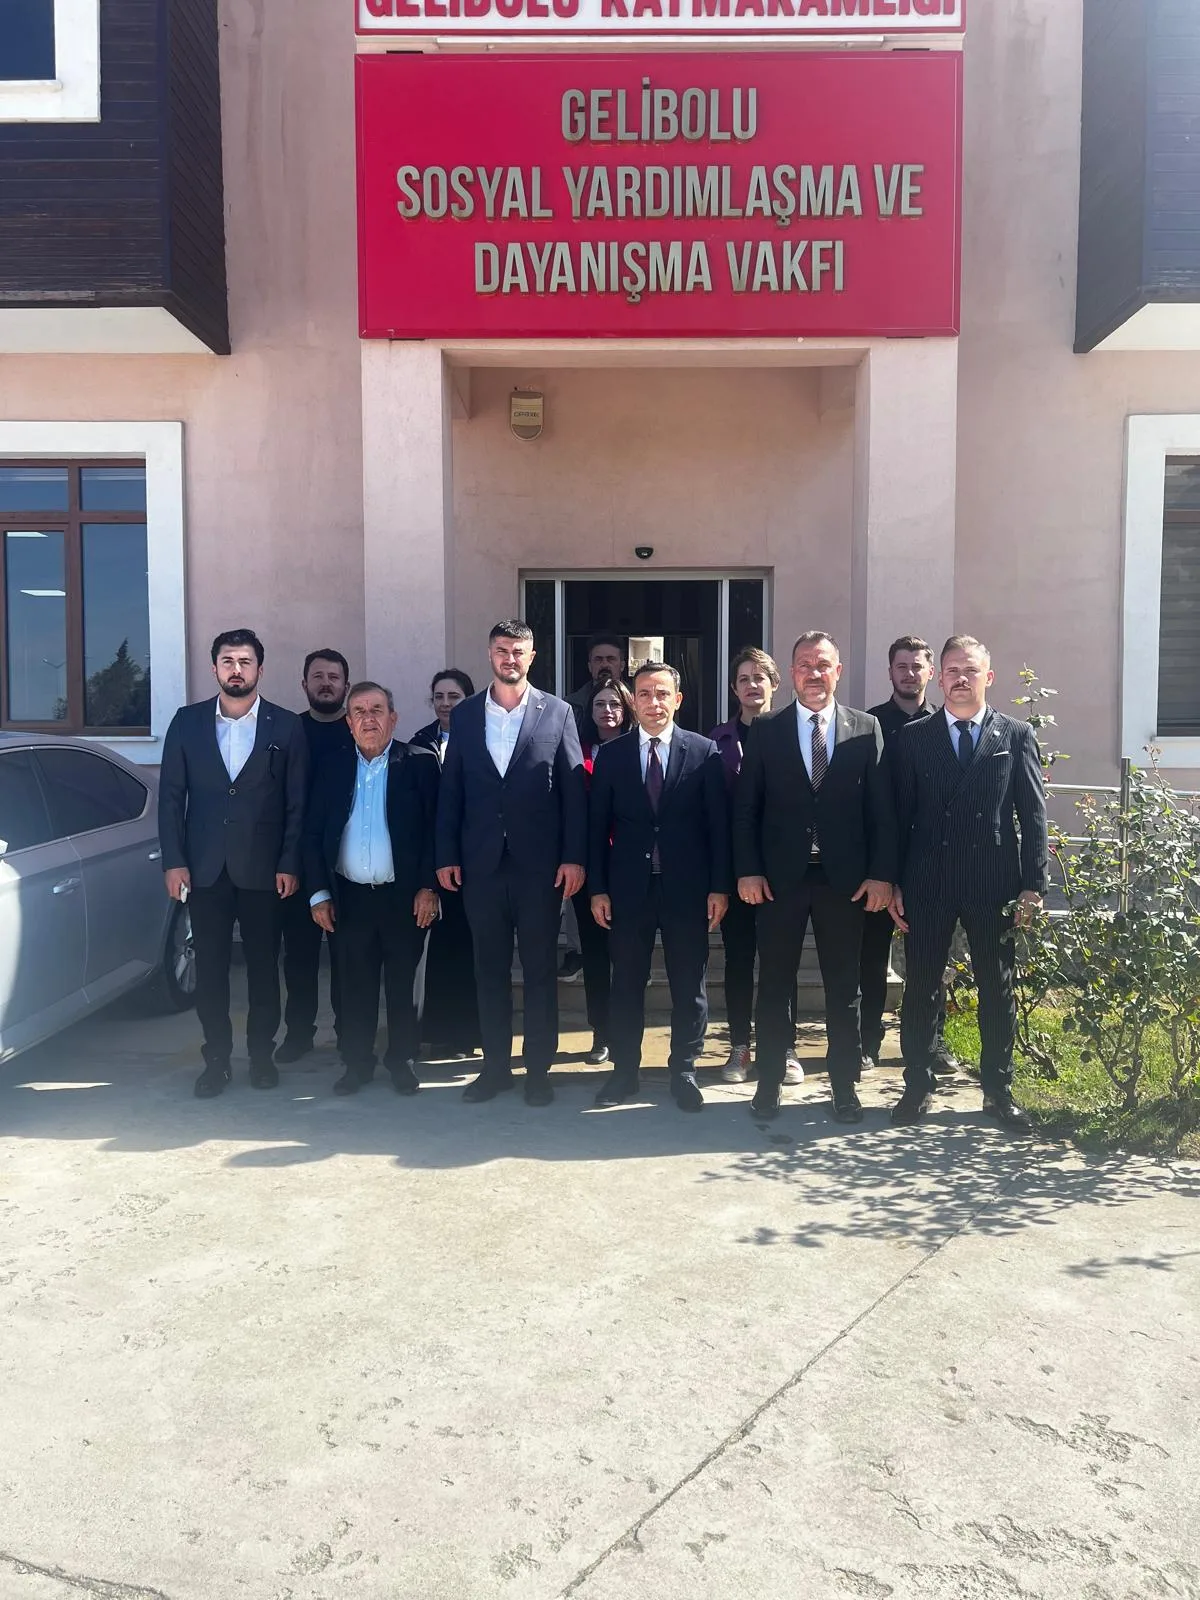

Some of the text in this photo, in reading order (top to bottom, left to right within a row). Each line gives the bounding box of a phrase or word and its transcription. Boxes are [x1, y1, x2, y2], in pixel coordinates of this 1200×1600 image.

[561, 76, 758, 143] GELİBOLU
[396, 164, 925, 227] SOSYAL YARDIMLAŞMA VE
[474, 240, 845, 303] DAYANIŞMA VAKFI
